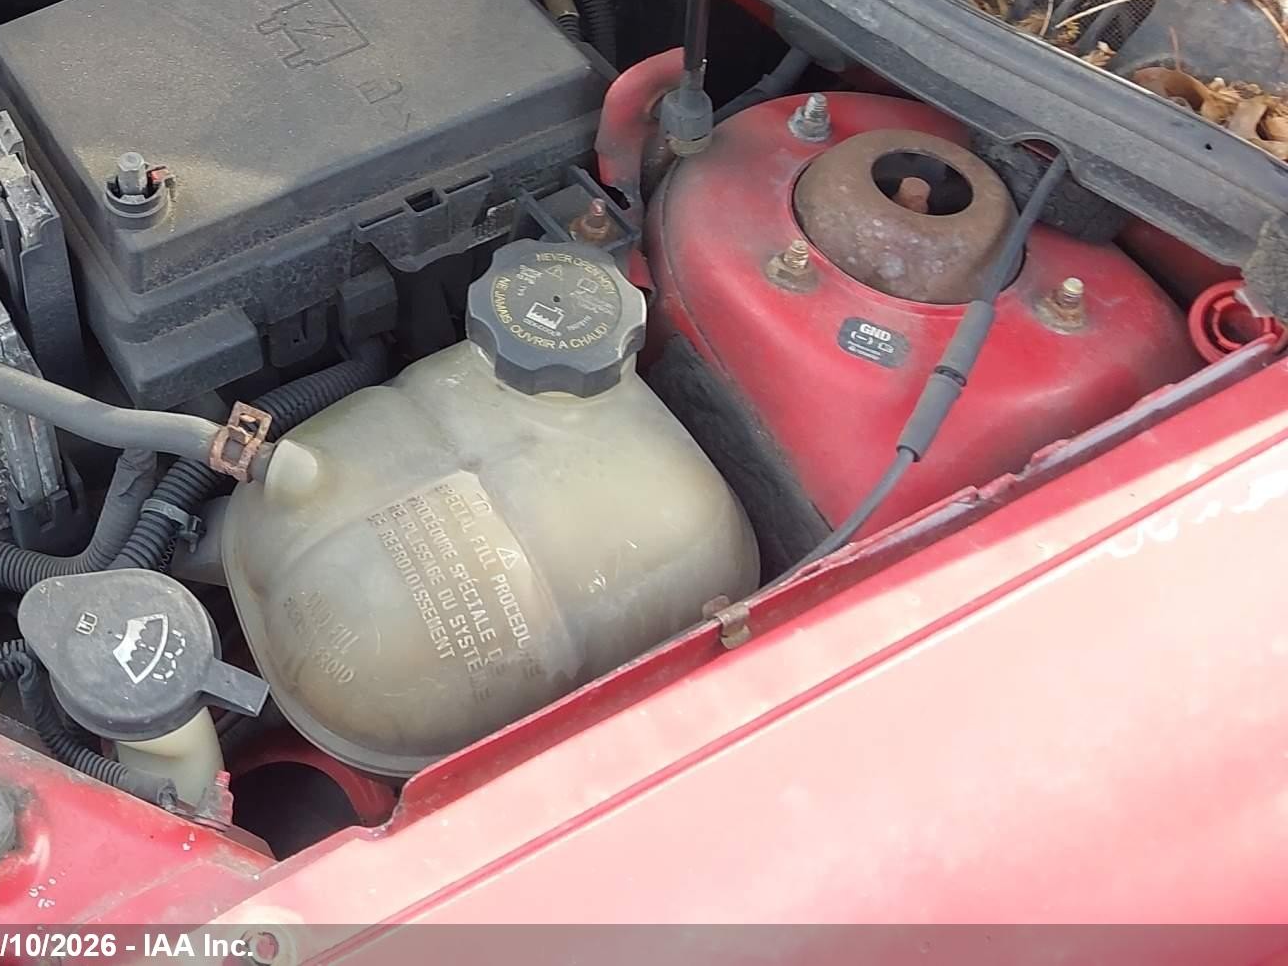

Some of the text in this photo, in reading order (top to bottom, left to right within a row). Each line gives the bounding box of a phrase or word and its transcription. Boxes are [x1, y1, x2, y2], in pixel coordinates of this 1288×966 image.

[859, 323, 892, 342] GND
[388, 502, 447, 586] REPLISSAGE
[437, 588, 459, 611] DU
[449, 563, 497, 643] SPÉCIALE
[469, 535, 498, 571] FILL
[491, 573, 543, 679] PROCEDUE
